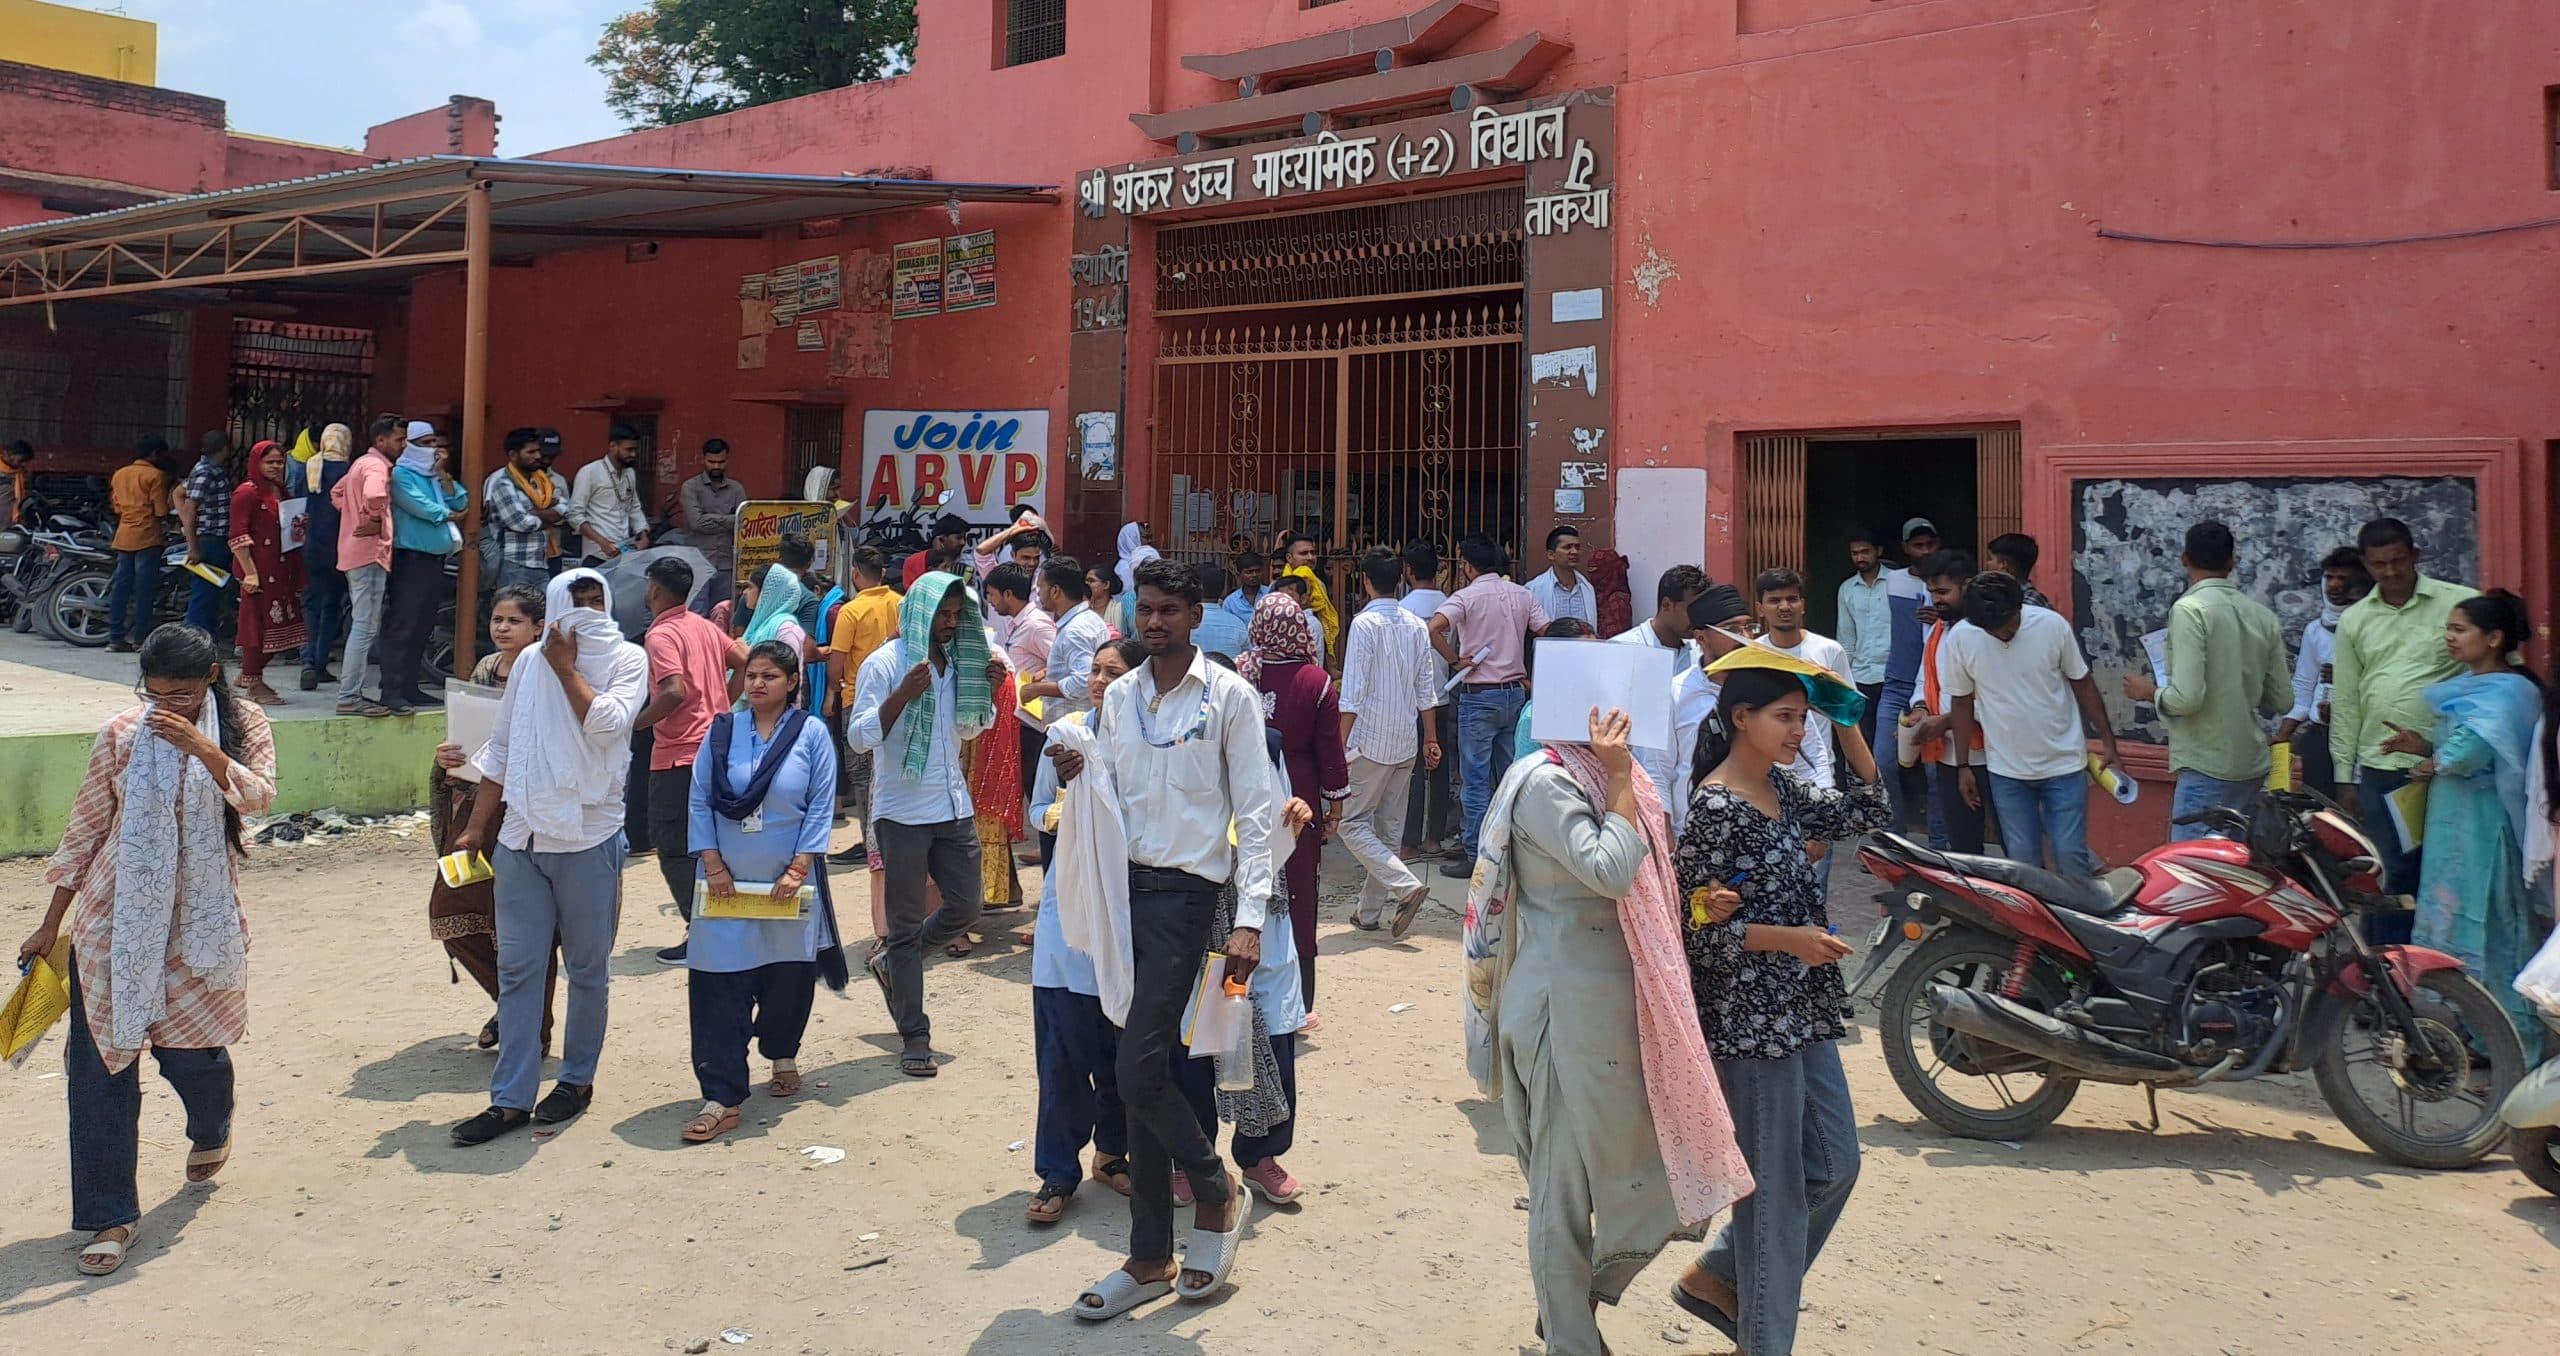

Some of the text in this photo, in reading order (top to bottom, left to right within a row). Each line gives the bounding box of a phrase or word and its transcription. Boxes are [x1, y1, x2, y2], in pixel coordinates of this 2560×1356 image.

[1079, 168, 1105, 218] श्री
[1113, 163, 1175, 214] शंकर
[1182, 158, 1235, 206] उच्च
[1251, 130, 1377, 197] माध्यमिक
[1386, 128, 1455, 181] (+2)
[893, 412, 1021, 452] Join
